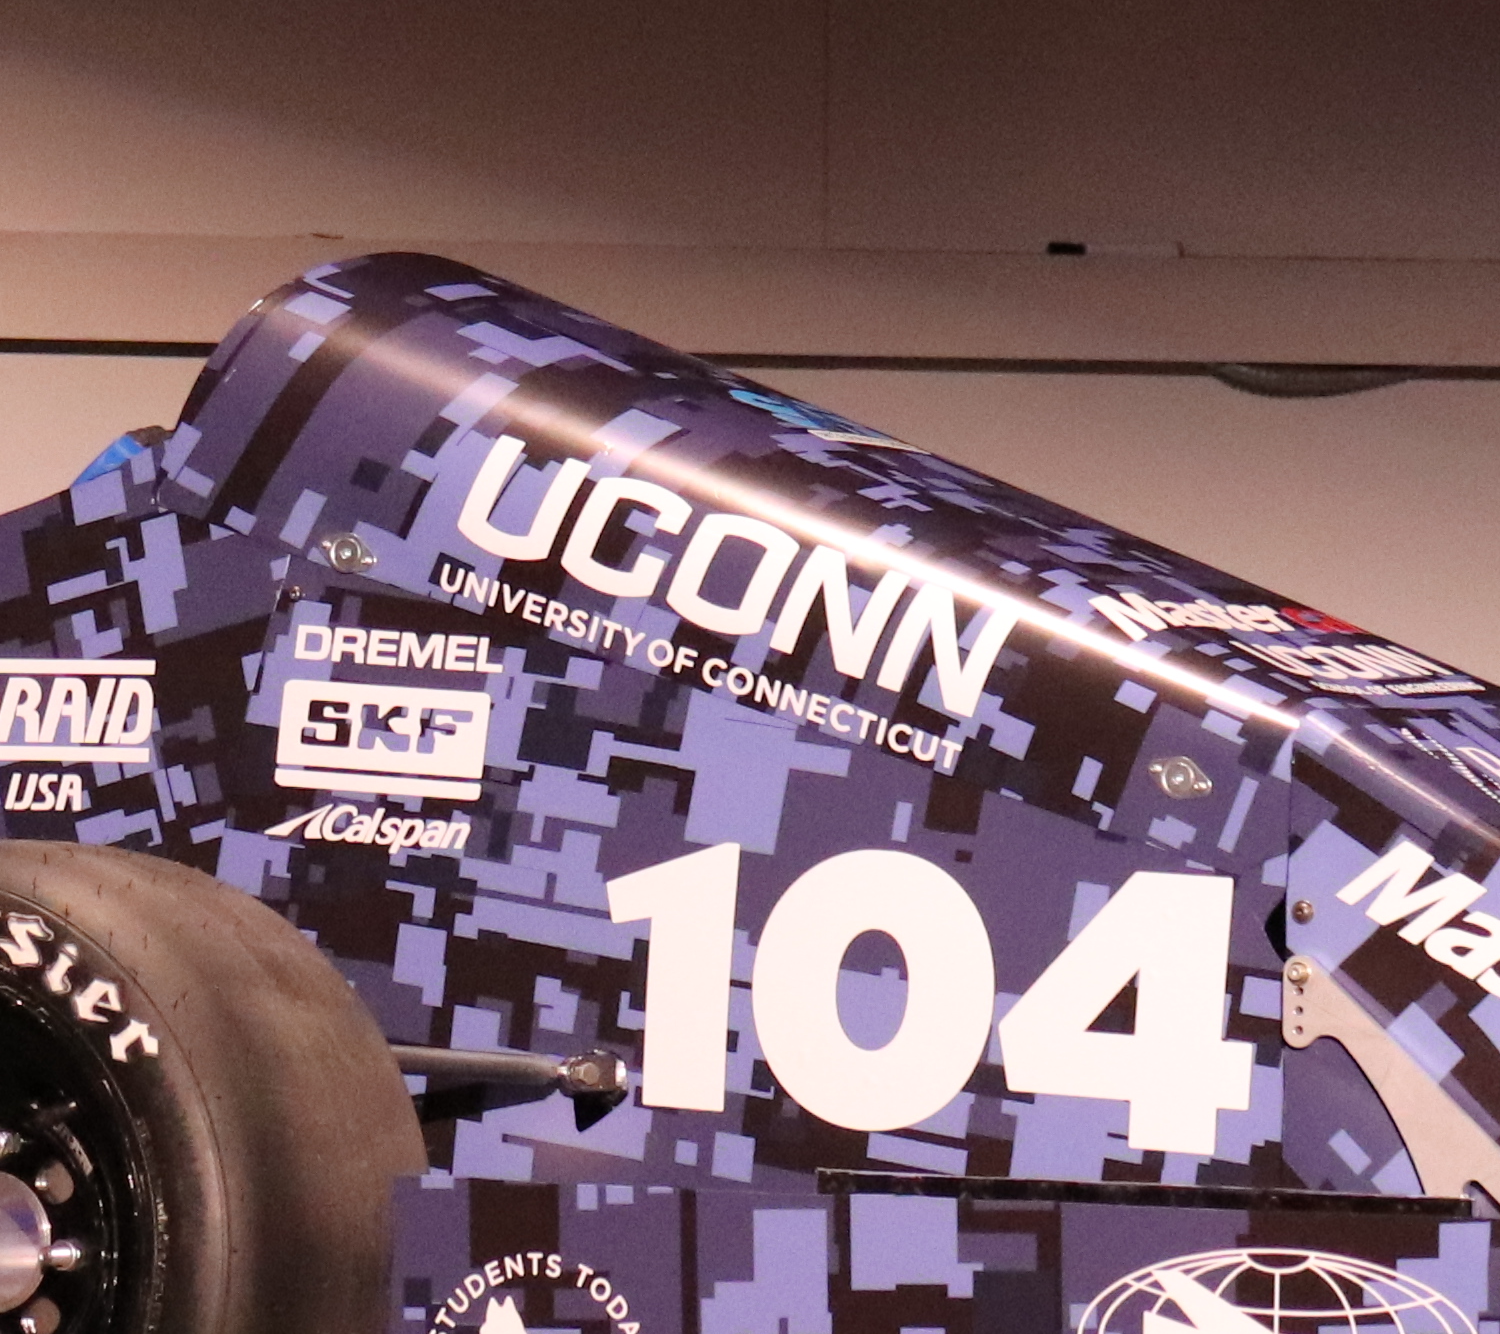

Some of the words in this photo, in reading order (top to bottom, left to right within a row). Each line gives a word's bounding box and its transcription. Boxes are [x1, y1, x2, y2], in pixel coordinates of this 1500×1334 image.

[457, 433, 1025, 719] UCONN
[294, 624, 504, 674] DREMEL
[440, 562, 647, 660] UNIVERSITY
[647, 637, 698, 688] OF
[701, 656, 966, 771] CONNECTICUT
[1228, 637, 1456, 681] UCONN
[300, 698, 473, 755] SKF
[4, 772, 84, 812] USA
[322, 804, 471, 855] Calspan
[605, 841, 1254, 1156] 104
